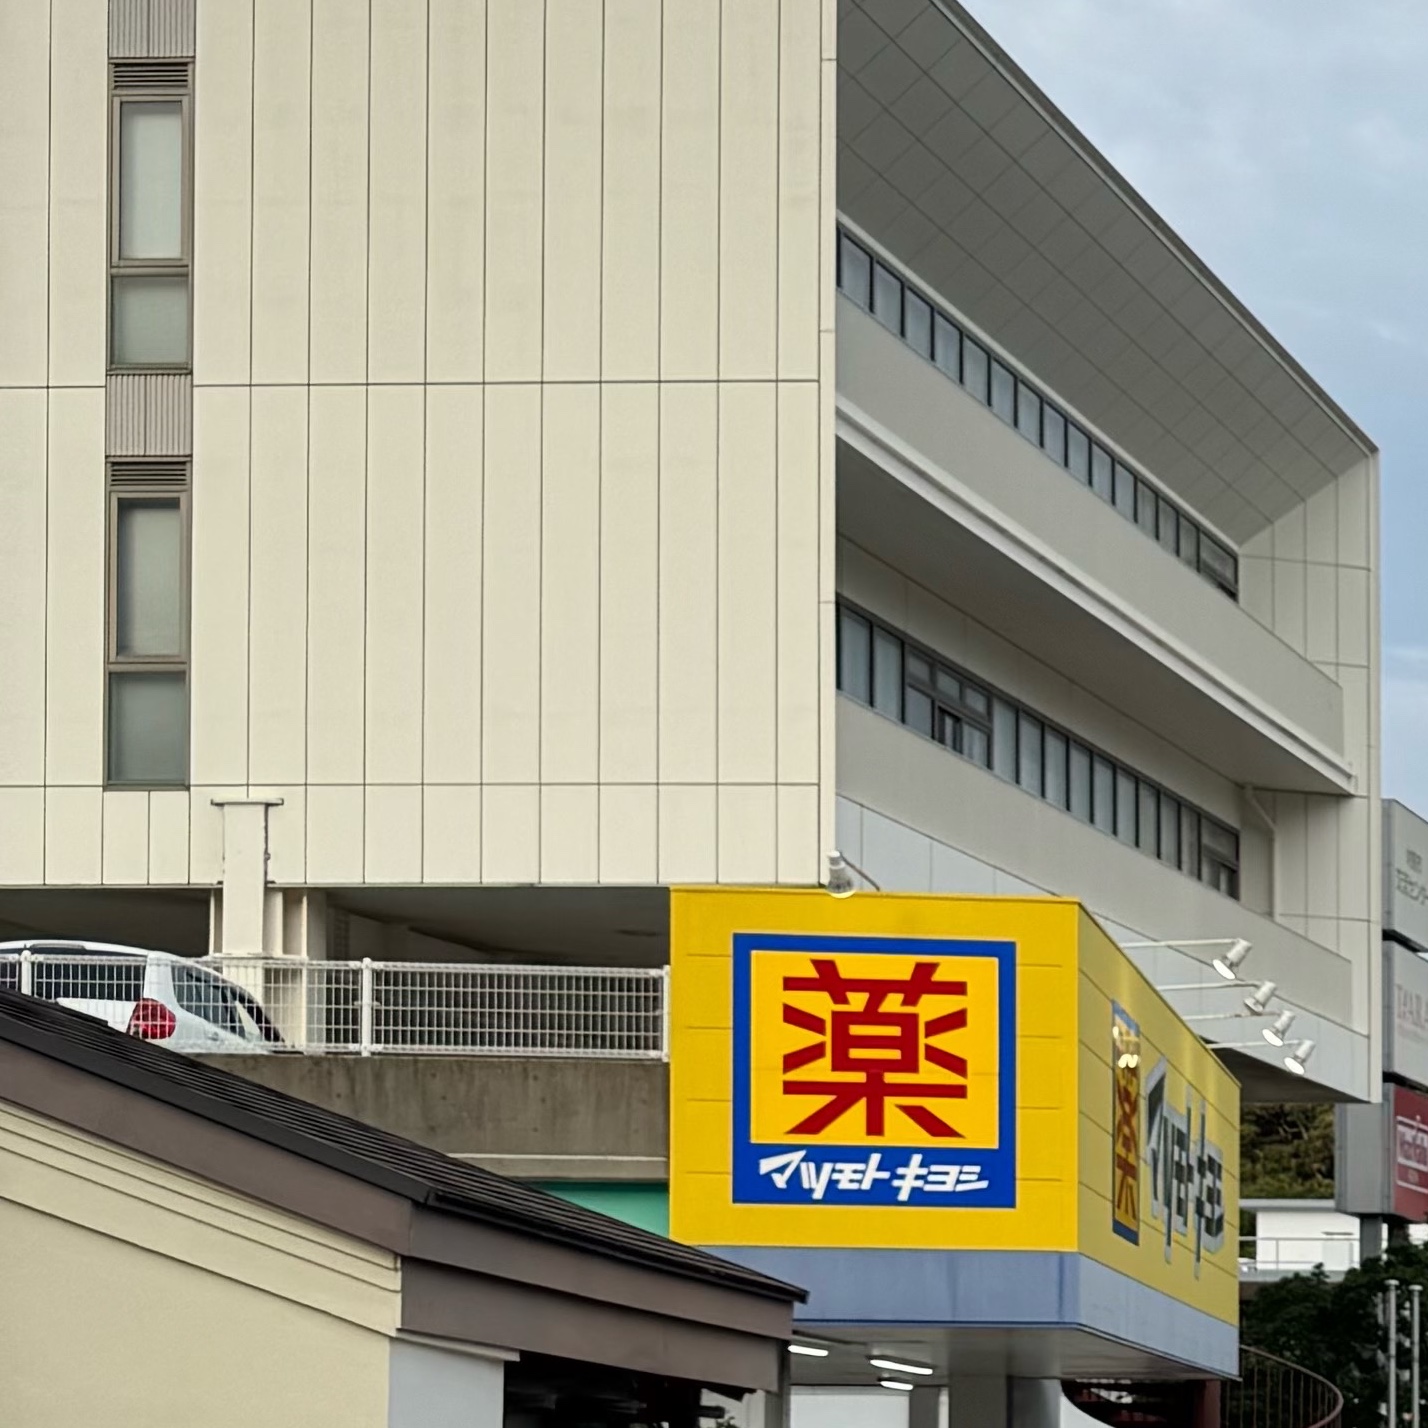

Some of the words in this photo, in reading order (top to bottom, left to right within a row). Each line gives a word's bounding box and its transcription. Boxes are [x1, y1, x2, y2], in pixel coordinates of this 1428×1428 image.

[783, 958, 967, 1138] 薬
[759, 1149, 989, 1202] マツモトキヨシ
